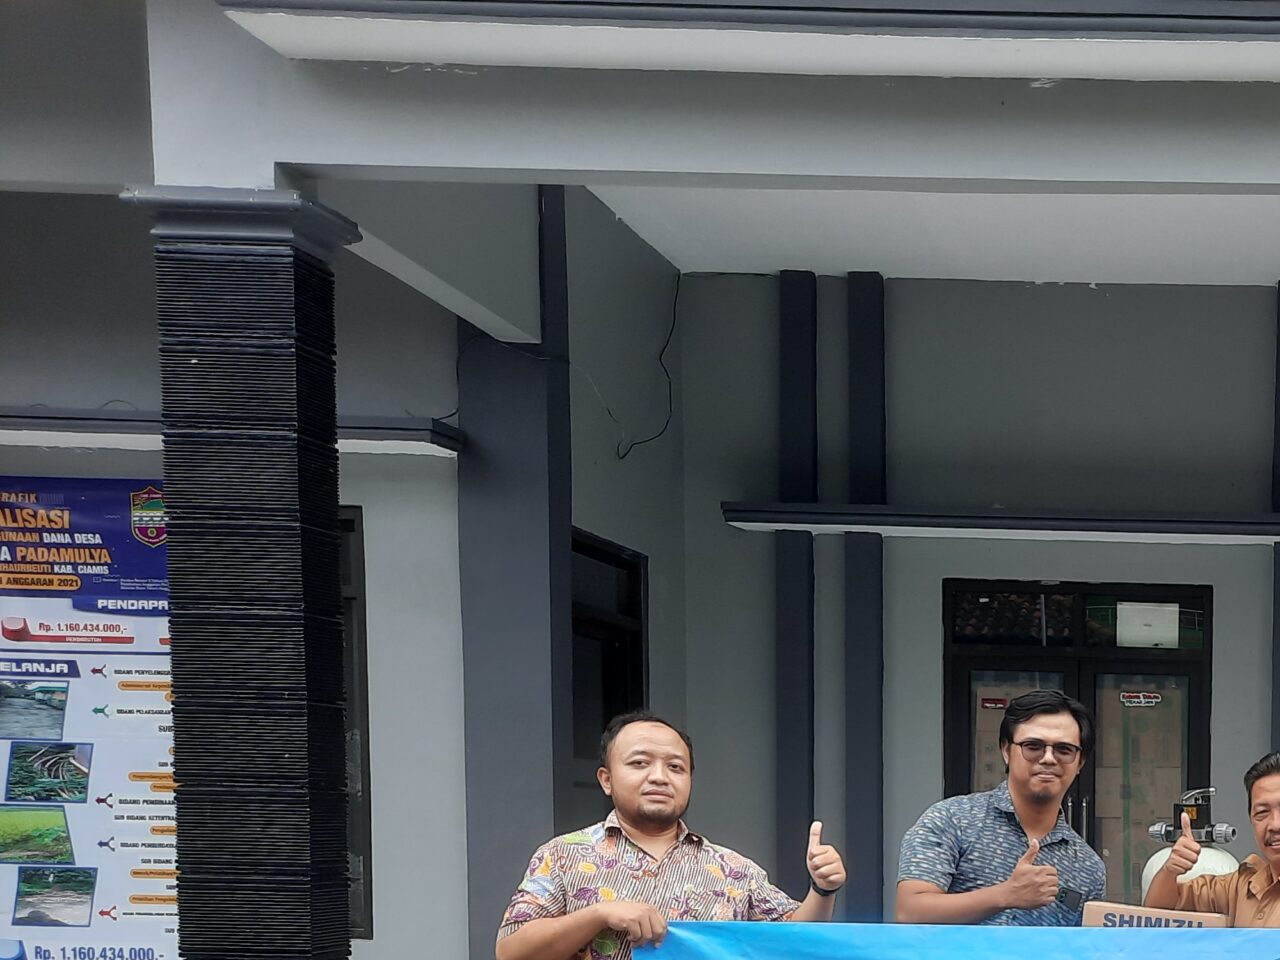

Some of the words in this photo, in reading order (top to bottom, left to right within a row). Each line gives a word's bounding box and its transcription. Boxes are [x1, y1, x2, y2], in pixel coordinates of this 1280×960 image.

[0, 492, 37, 504] RAFIK
[0, 531, 40, 543] UNAAN
[42, 532, 73, 544] DANA
[74, 533, 103, 545] DESA
[16, 546, 112, 564] PADAMULYA
[53, 564, 75, 575] KAB.
[77, 565, 110, 575] CIAMIS
[6, 577, 54, 588] ANGGARAN
[57, 578, 79, 588] 2021
[97, 599, 169, 611] PENDAPA
[38, 622, 54, 633] Rp.
